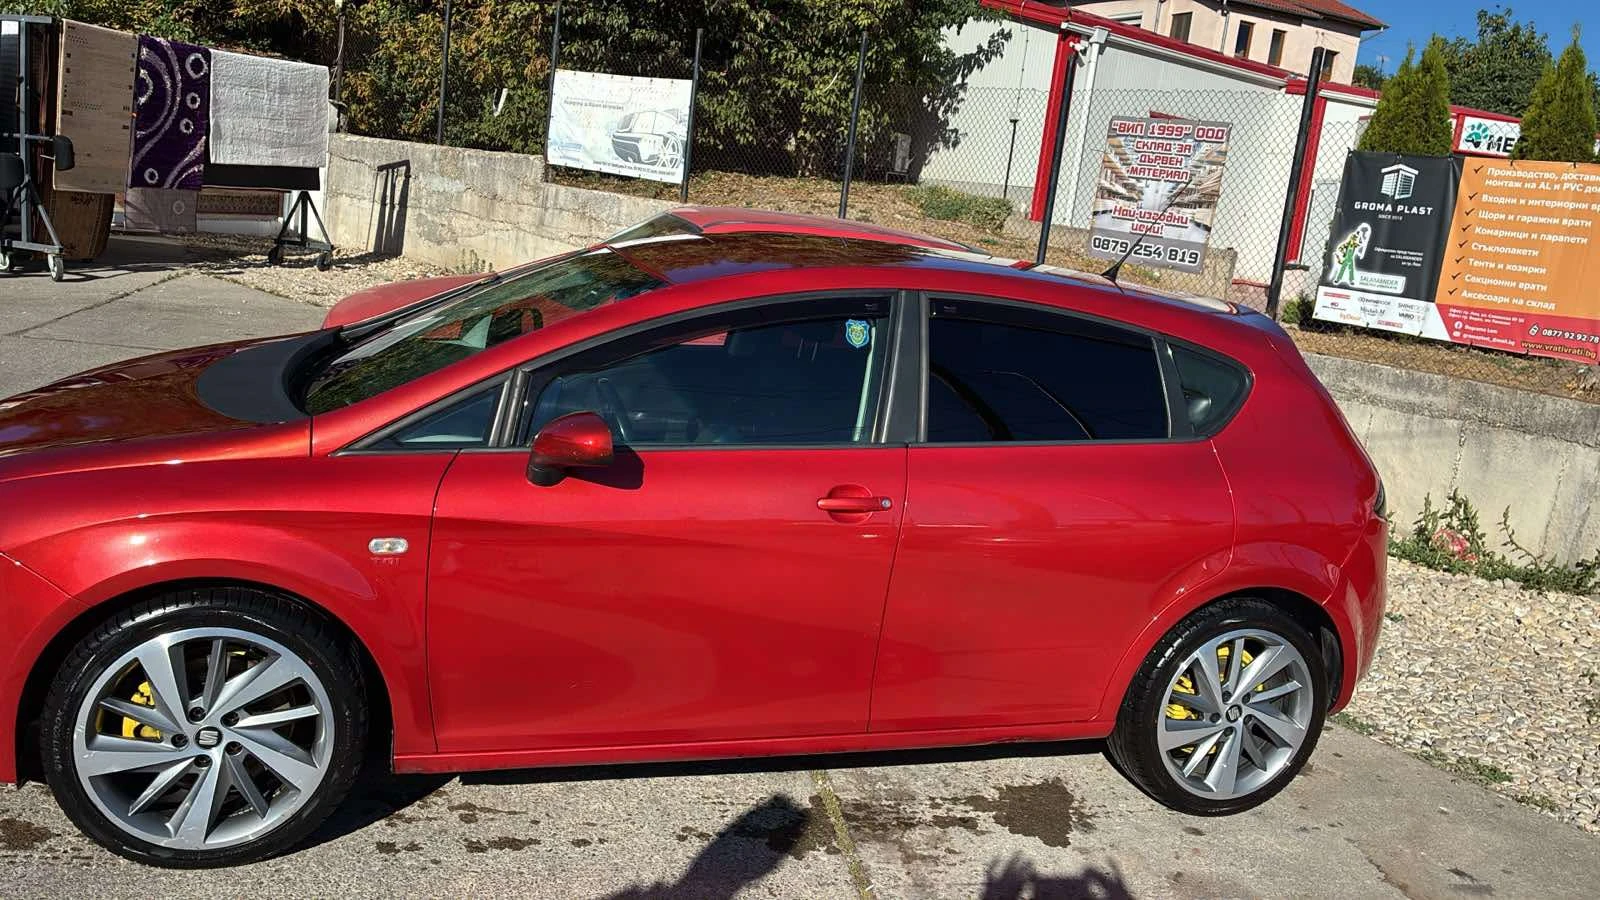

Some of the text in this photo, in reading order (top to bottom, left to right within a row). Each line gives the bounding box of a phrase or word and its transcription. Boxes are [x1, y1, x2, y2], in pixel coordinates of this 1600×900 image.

[1195, 127, 1226, 141] ООД
[1135, 140, 1192, 154] СКЛАД ЗА
[1486, 133, 1521, 153] ME
[1138, 155, 1184, 167] ДЪРВЕН
[1129, 166, 1189, 181] МАТЕРИАЛ
[1487, 168, 1559, 180] Производство,
[1485, 180, 1522, 189] монтаж
[1538, 182, 1551, 190] AL
[1563, 183, 1583, 192] PVC
[1354, 201, 1434, 216] GROMA PLAST
[1482, 194, 1517, 205] Входни
[1528, 199, 1588, 209] интериорни
[1112, 205, 1189, 225] Най-изгодни
[1478, 209, 1505, 221] Щори
[1517, 215, 1560, 225] гаражни
[1562, 219, 1592, 228] врати
[1131, 222, 1164, 235] цени!
[1475, 226, 1529, 239] Комарници
[1540, 233, 1588, 244] парапети
[1092, 237, 1199, 265] 0879 254 819
[1471, 242, 1539, 256] Стъклопакети
[1468, 258, 1495, 269] Тенти
[1506, 264, 1547, 275] козирки
[1464, 274, 1547, 292] Секционни врати
[1461, 290, 1509, 304] Аксесоари
[1526, 300, 1556, 311] склад
[1542, 328, 1600, 344] 0877 92 92 78
[1521, 341, 1597, 359] www.vrativrati.bg
